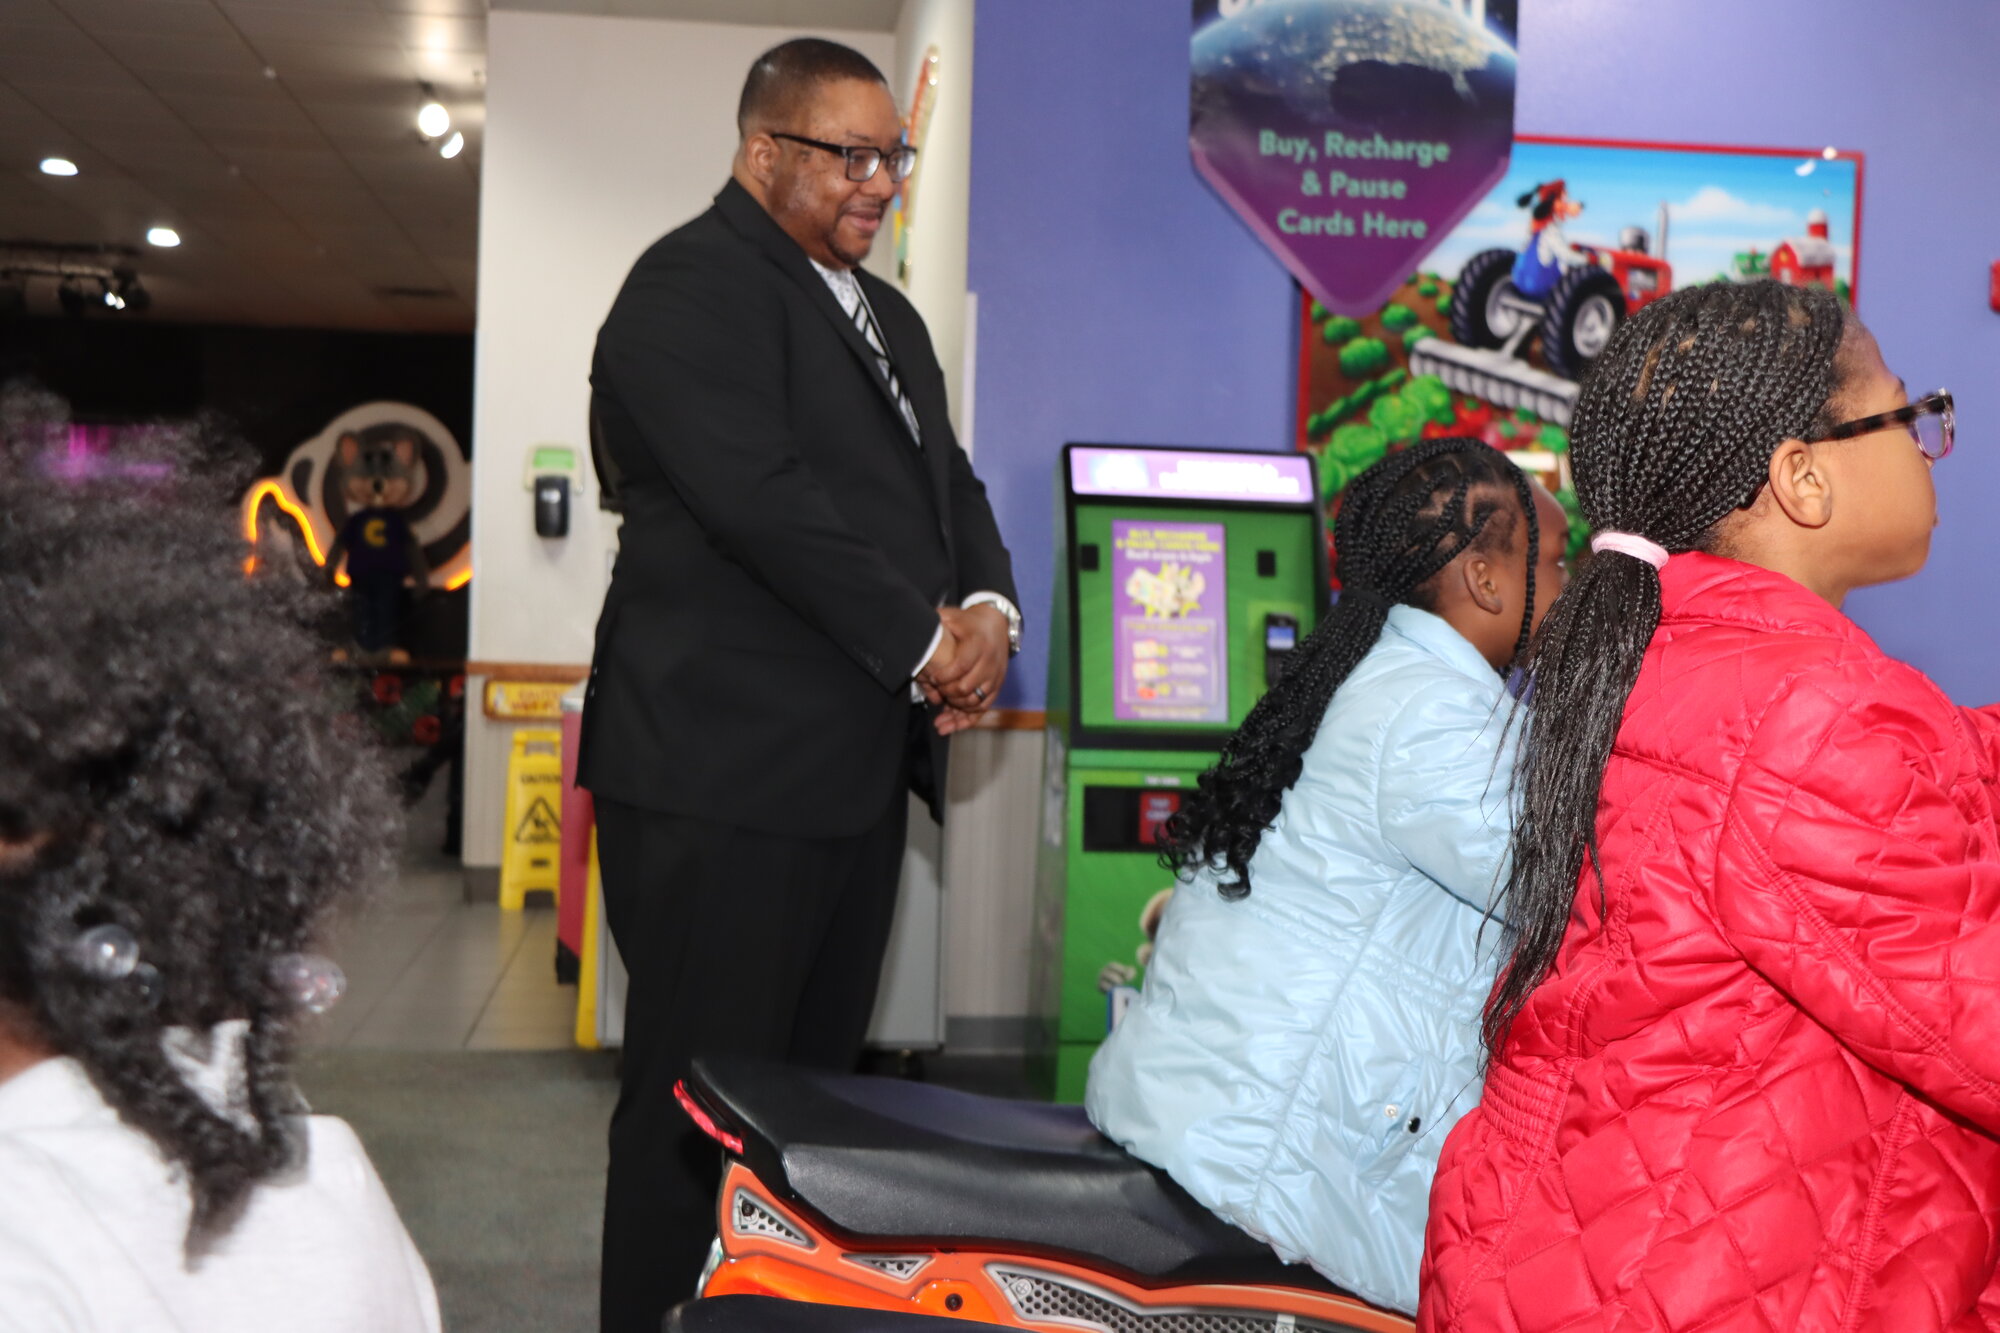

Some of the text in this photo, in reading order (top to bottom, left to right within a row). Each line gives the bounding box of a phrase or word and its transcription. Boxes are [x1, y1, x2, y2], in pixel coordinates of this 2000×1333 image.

[1258, 129, 1450, 168] Buy, Recharge
[1300, 169, 1407, 200] & Pause
[1276, 208, 1428, 240] Cards Here
[364, 518, 386, 547] C
